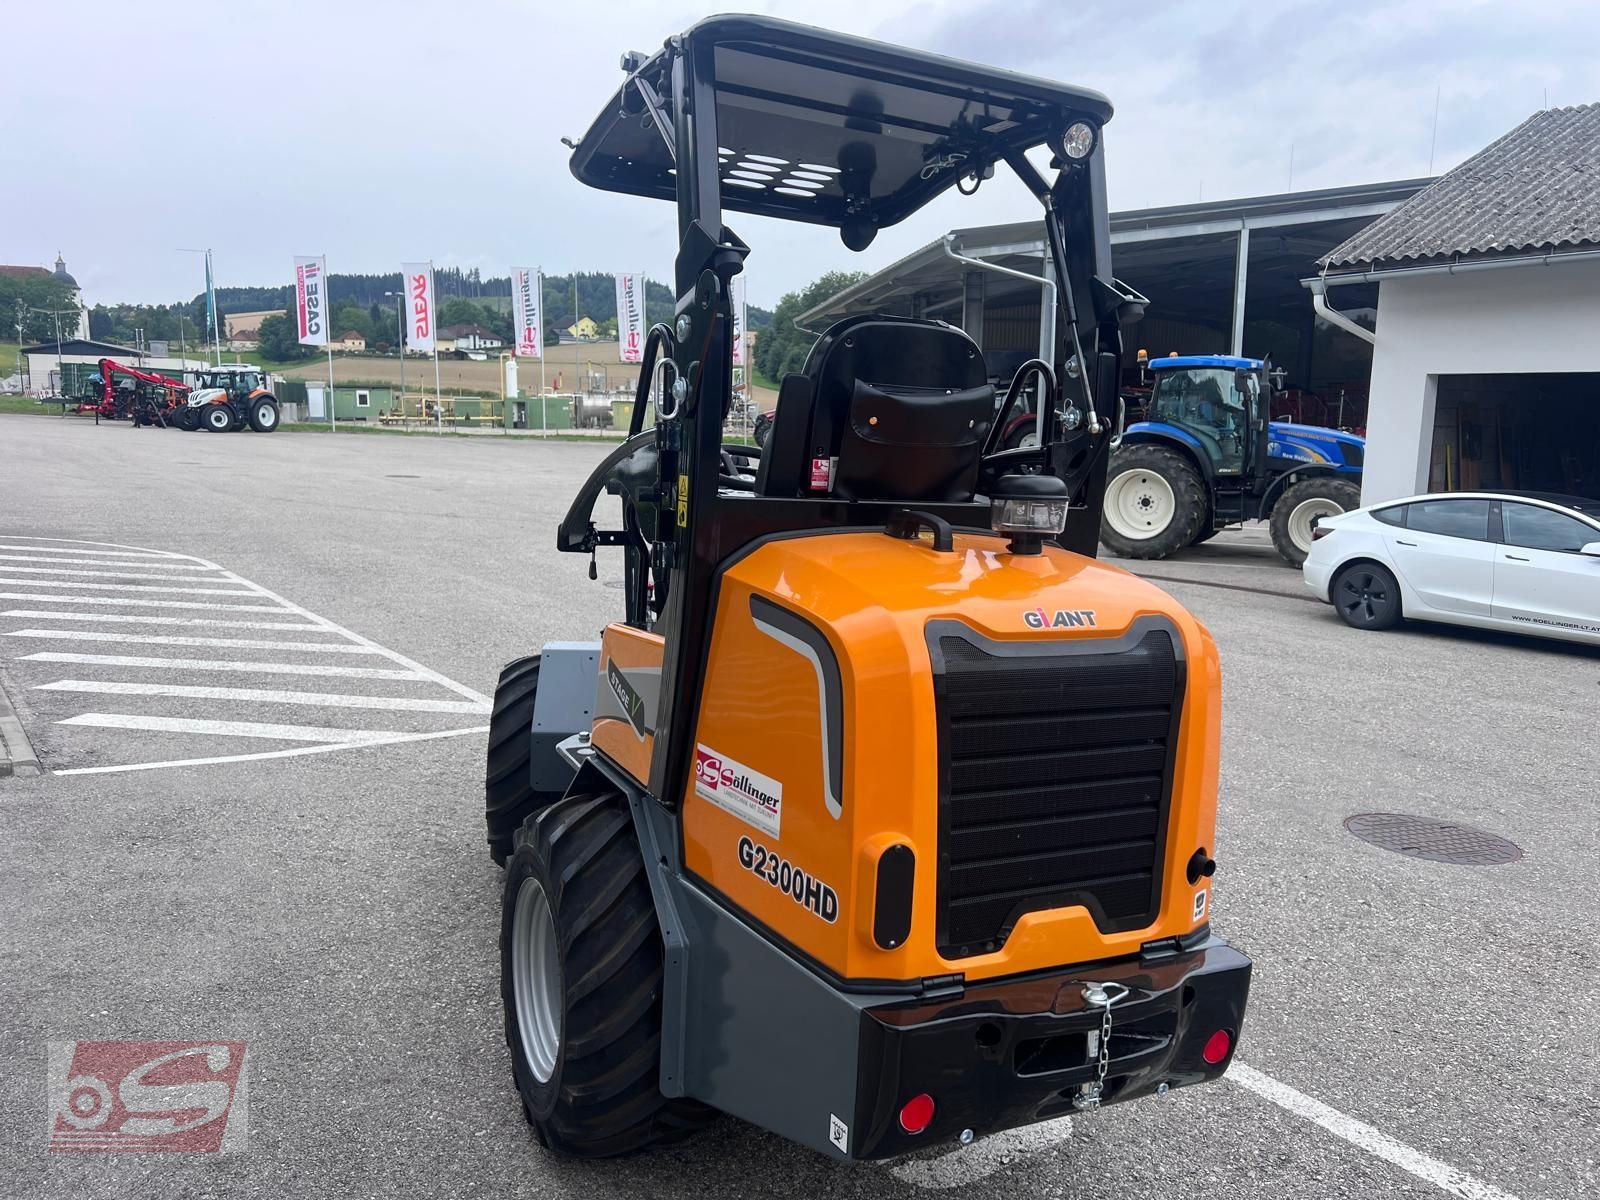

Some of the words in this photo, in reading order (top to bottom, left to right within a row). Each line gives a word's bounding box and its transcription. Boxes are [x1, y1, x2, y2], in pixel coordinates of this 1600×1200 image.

[611, 671, 630, 709] STAGE
[720, 768, 780, 808] Söllinger
[738, 835, 839, 924] G2300HD
